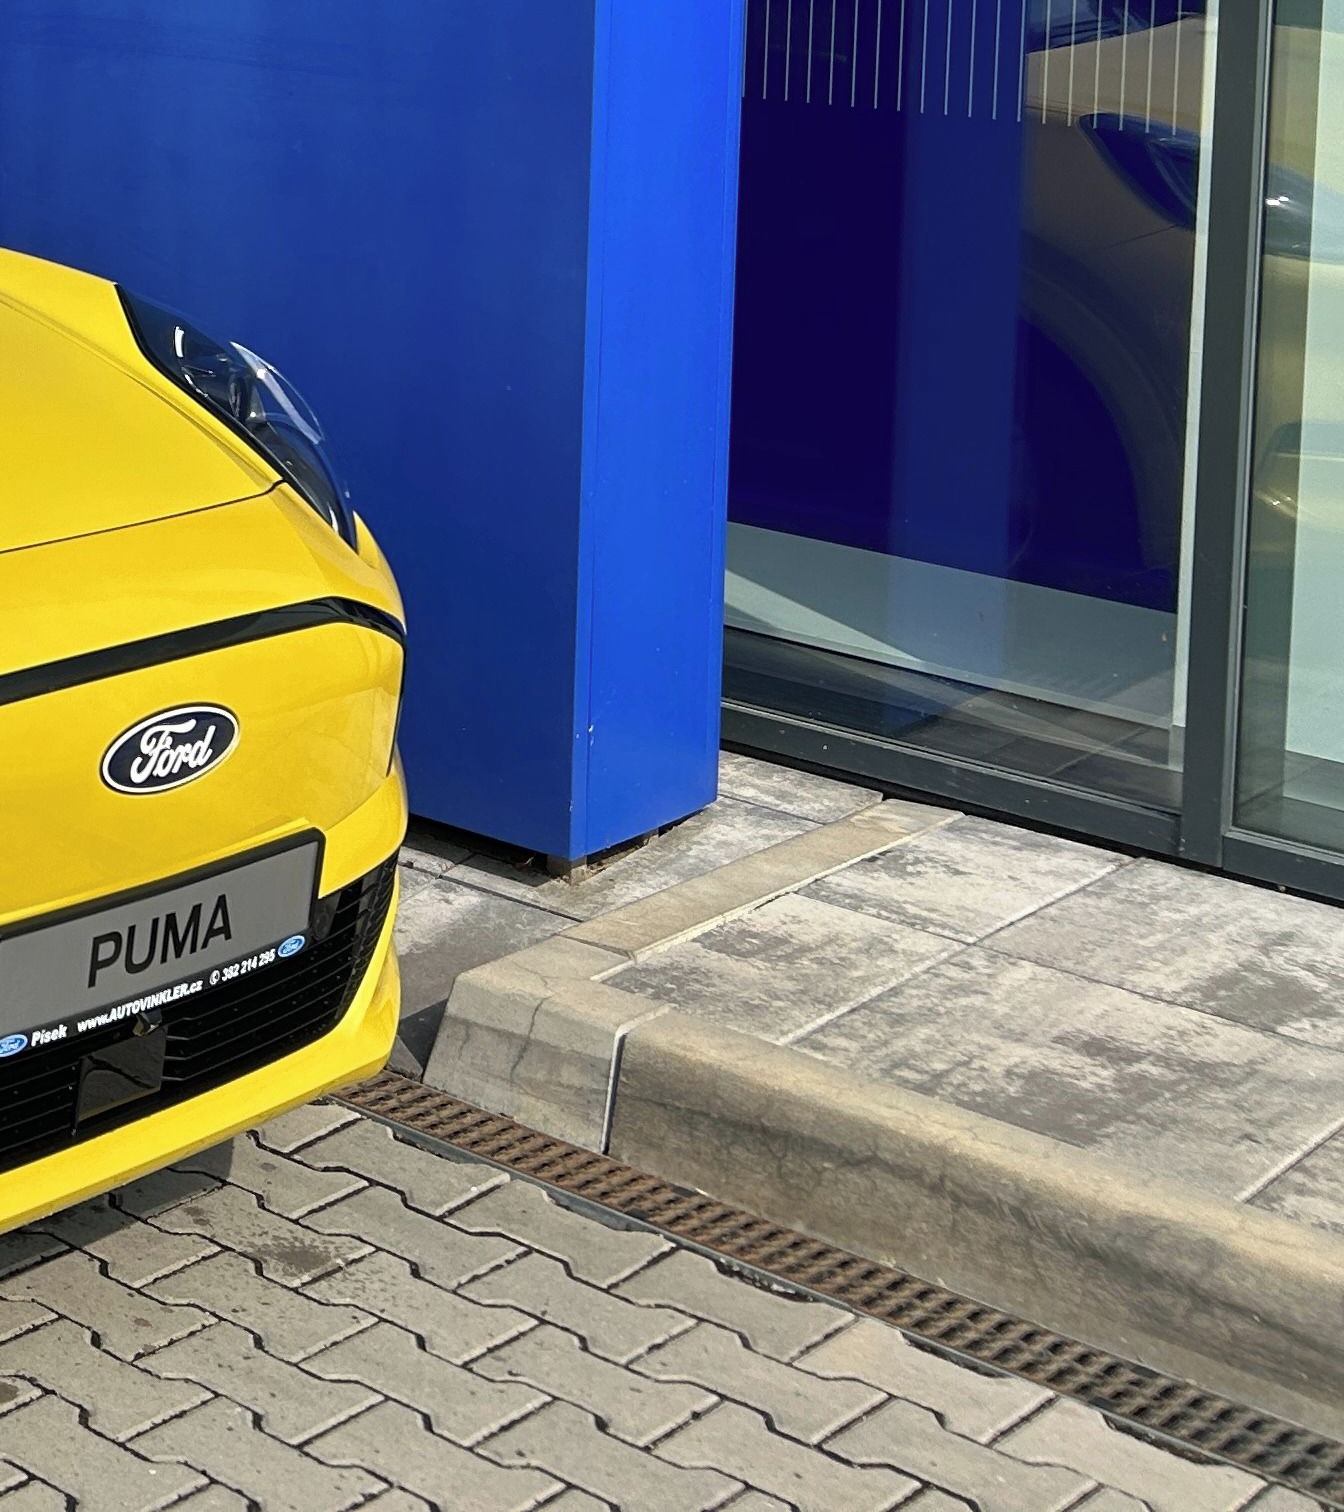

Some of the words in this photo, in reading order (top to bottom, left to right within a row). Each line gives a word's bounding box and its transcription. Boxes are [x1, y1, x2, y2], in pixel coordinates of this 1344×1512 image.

[129, 718, 216, 784] Ford
[87, 893, 234, 989] PUMA
[77, 979, 204, 1033] www.AUTOVINKLER.cz
